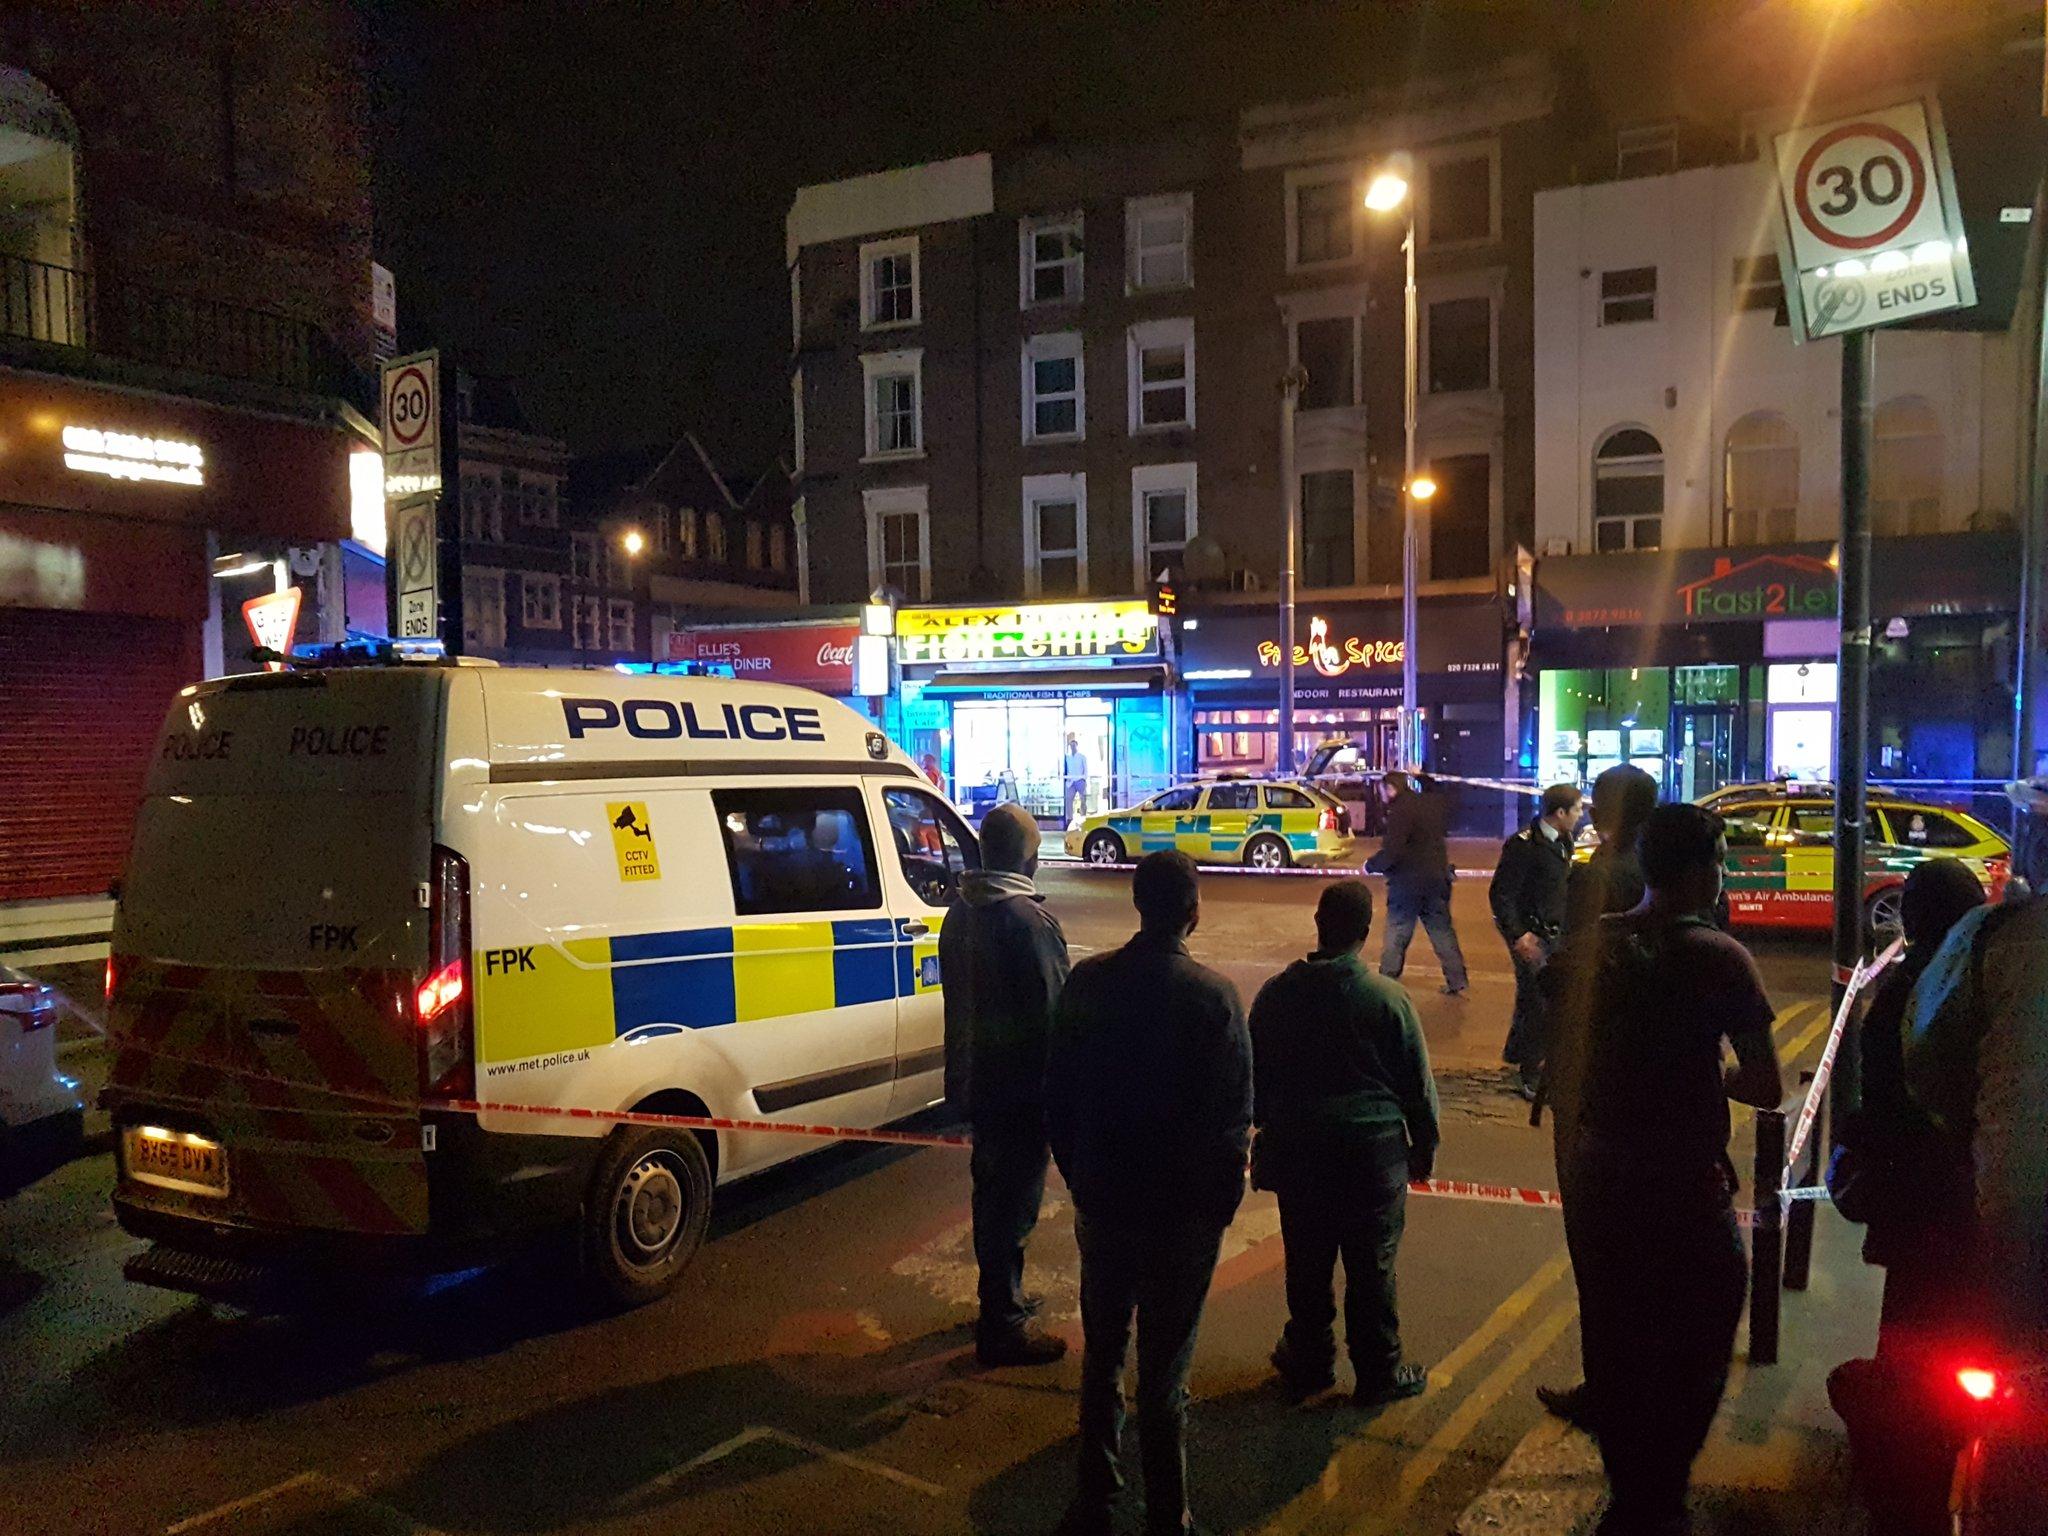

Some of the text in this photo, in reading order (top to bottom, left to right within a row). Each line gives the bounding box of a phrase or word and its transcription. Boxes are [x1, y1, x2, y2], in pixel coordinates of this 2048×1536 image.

[1816, 155, 1904, 217] 30
[1877, 278, 1947, 311] ENDS
[396, 389, 424, 422] 30
[406, 616, 428, 636] ENDS
[923, 613, 1000, 626] ALEX
[698, 642, 741, 656] ELLIE'S
[1258, 637, 1406, 668] Fie Spice
[734, 657, 772, 670] DINER
[1037, 691, 1055, 699] FISH
[1066, 690, 1092, 698] CHIPS
[1293, 687, 1404, 699] NDOORI RESTAURANT
[560, 697, 826, 742] POLICE
[164, 730, 235, 760] POLICE
[289, 726, 389, 757] POLICE
[625, 850, 648, 861] CCTV
[624, 864, 655, 876] FITTED
[1754, 891, 1771, 901] Air
[310, 924, 359, 951] FPK
[486, 946, 536, 976] FPK
[487, 1049, 592, 1076] www.met.police.uk
[1436, 1180, 1451, 1192] DO
[1453, 1182, 1474, 1195] NOT
